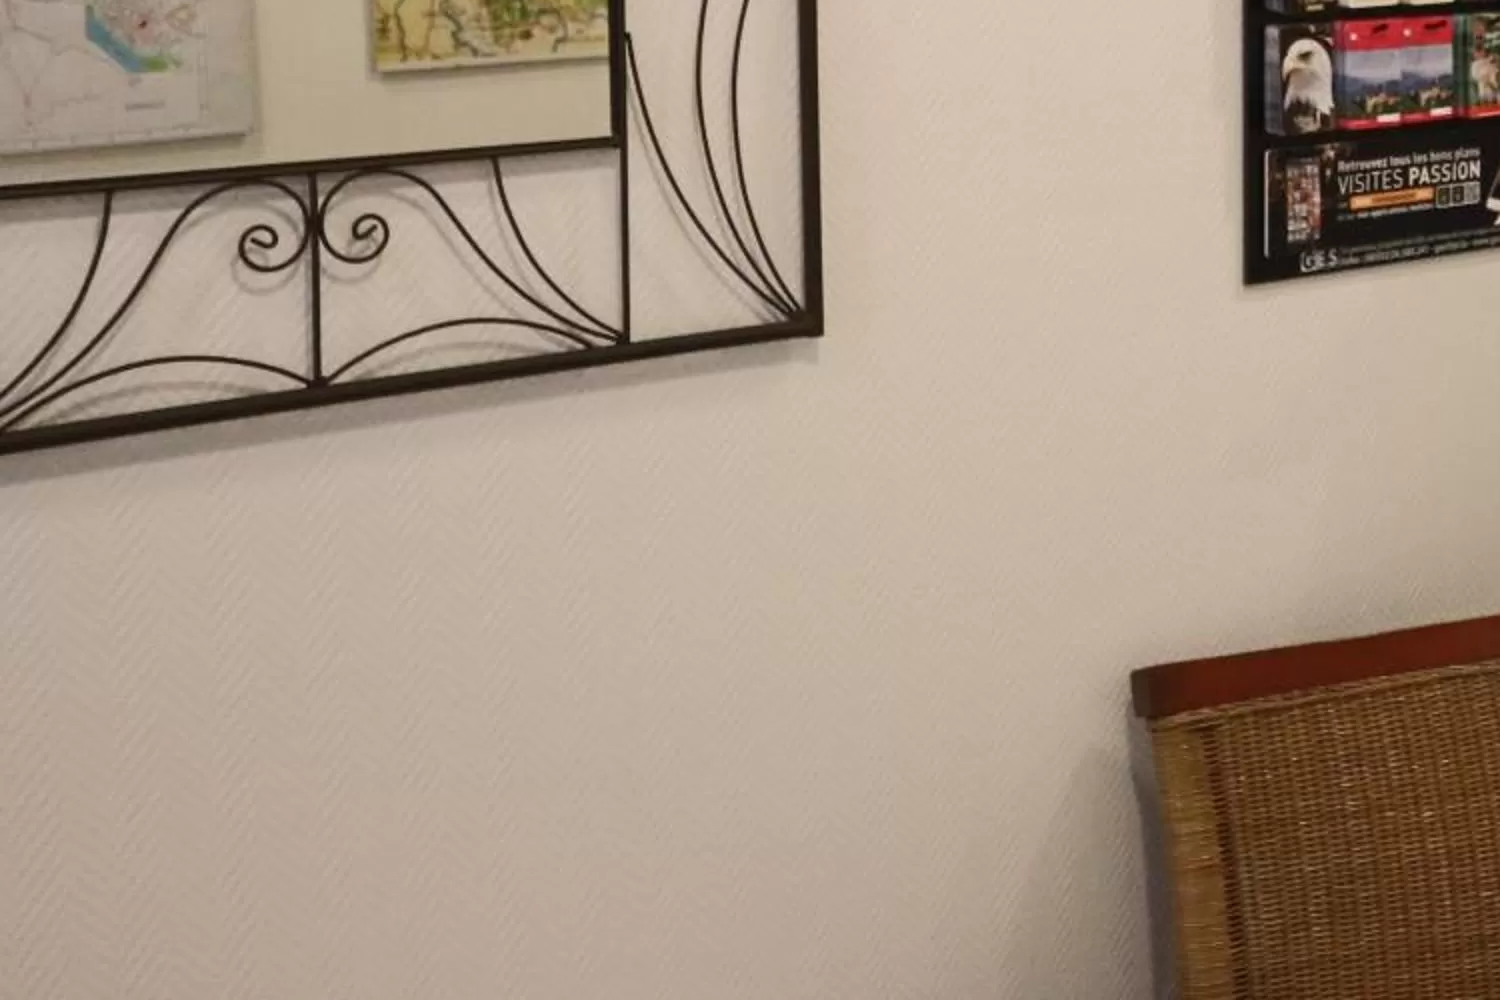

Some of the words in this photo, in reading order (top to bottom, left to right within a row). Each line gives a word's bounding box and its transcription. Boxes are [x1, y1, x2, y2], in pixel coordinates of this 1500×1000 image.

[1337, 157, 1388, 173] Retrouvez
[1337, 168, 1404, 195] VISITES
[1408, 159, 1481, 186] PASSION
